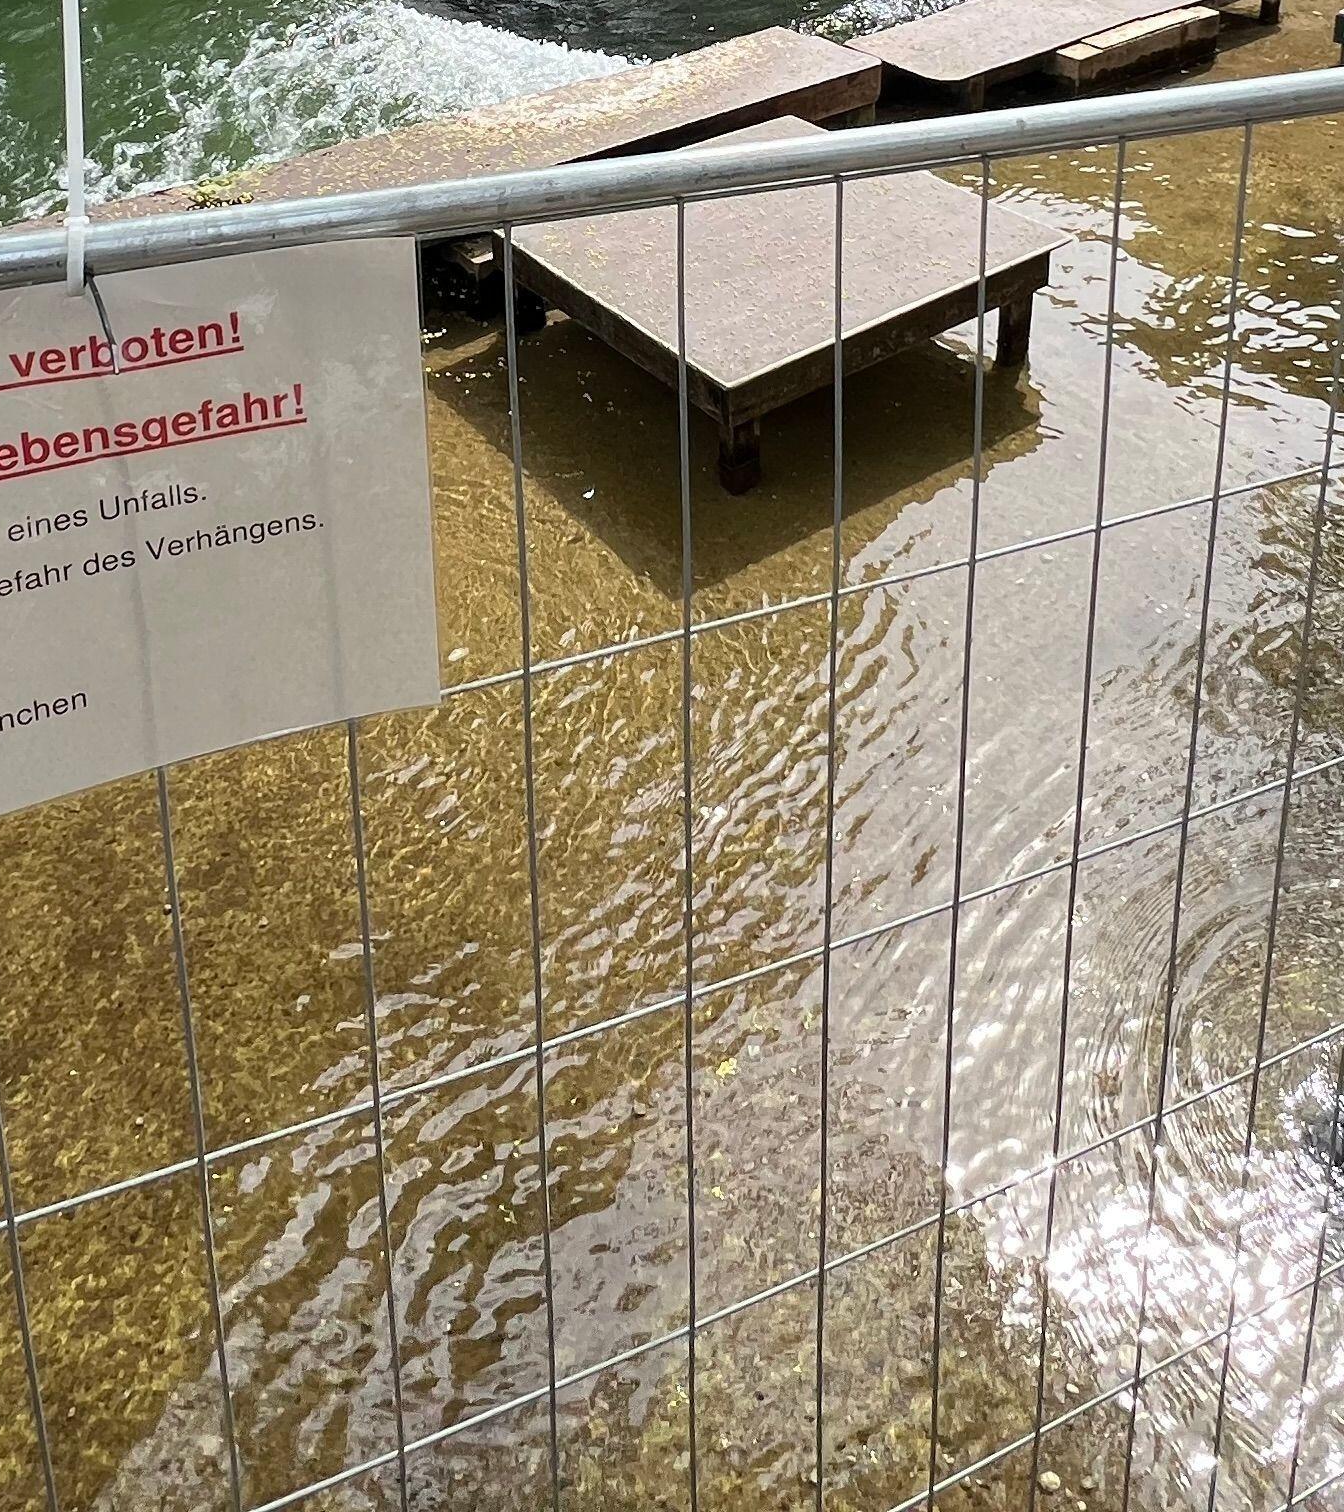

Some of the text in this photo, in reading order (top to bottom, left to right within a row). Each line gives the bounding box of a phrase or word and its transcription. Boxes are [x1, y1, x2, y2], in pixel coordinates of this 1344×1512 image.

[9, 311, 241, 379] verboten!
[7, 508, 89, 542] eines
[99, 484, 207, 521] Unfalls.
[82, 550, 136, 577] des
[144, 511, 325, 562] Verhängens.
